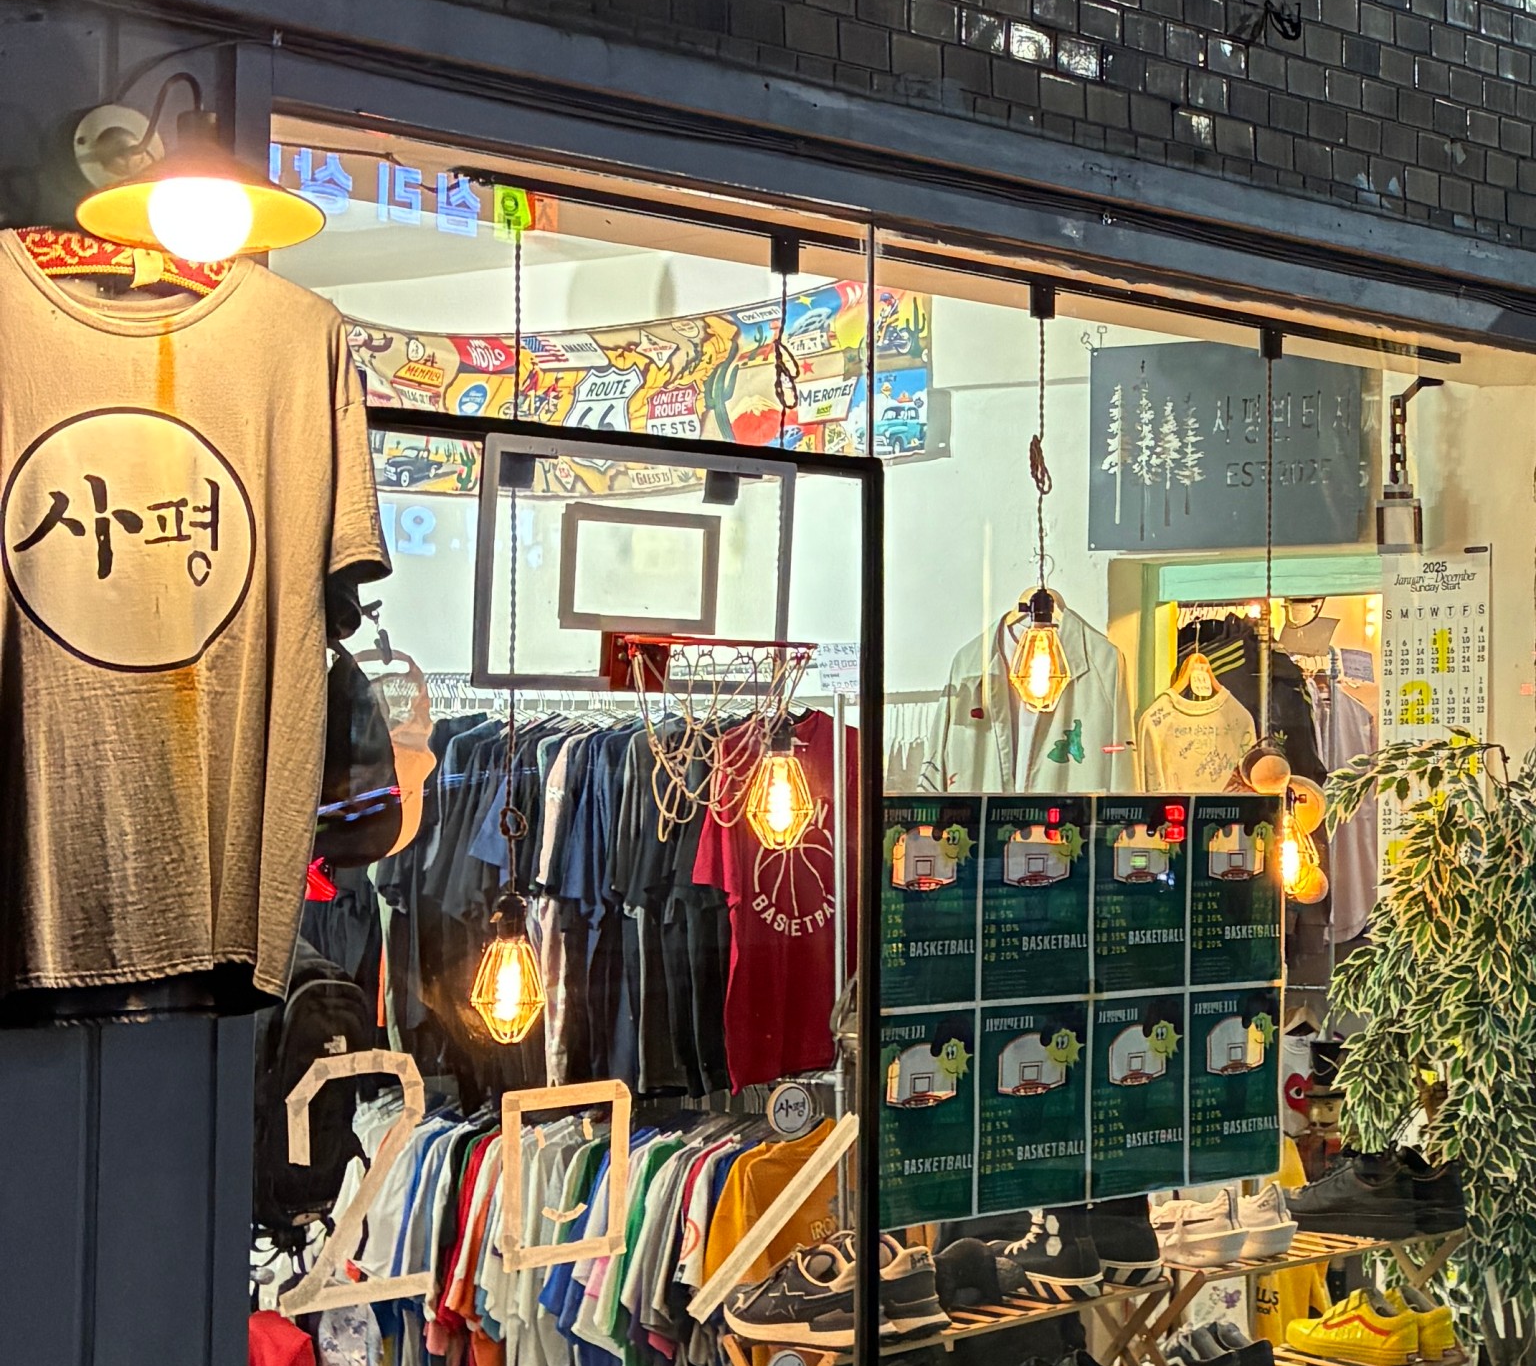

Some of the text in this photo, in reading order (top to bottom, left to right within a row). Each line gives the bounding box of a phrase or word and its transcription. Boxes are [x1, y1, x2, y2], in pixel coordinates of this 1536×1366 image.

[586, 379, 631, 398] ROUTE
[653, 389, 693, 406] UNITED
[13, 474, 220, 586] 사평
[1423, 561, 1448, 573] 2025
[1386, 604, 1485, 619] S M T W T F S
[1128, 928, 1185, 945] BASKETBALL
[1224, 924, 1280, 940] BASKETBALL
[909, 938, 975, 958] BASKETBALL
[1022, 933, 1088, 952] BASKETBALL
[776, 1097, 806, 1117] 사평
[1223, 1115, 1280, 1135] BASKETBALL
[1126, 1127, 1184, 1149] BASKETBALL
[1016, 1140, 1086, 1161] BASKETBALL
[904, 1153, 973, 1176] BASKETBALL
